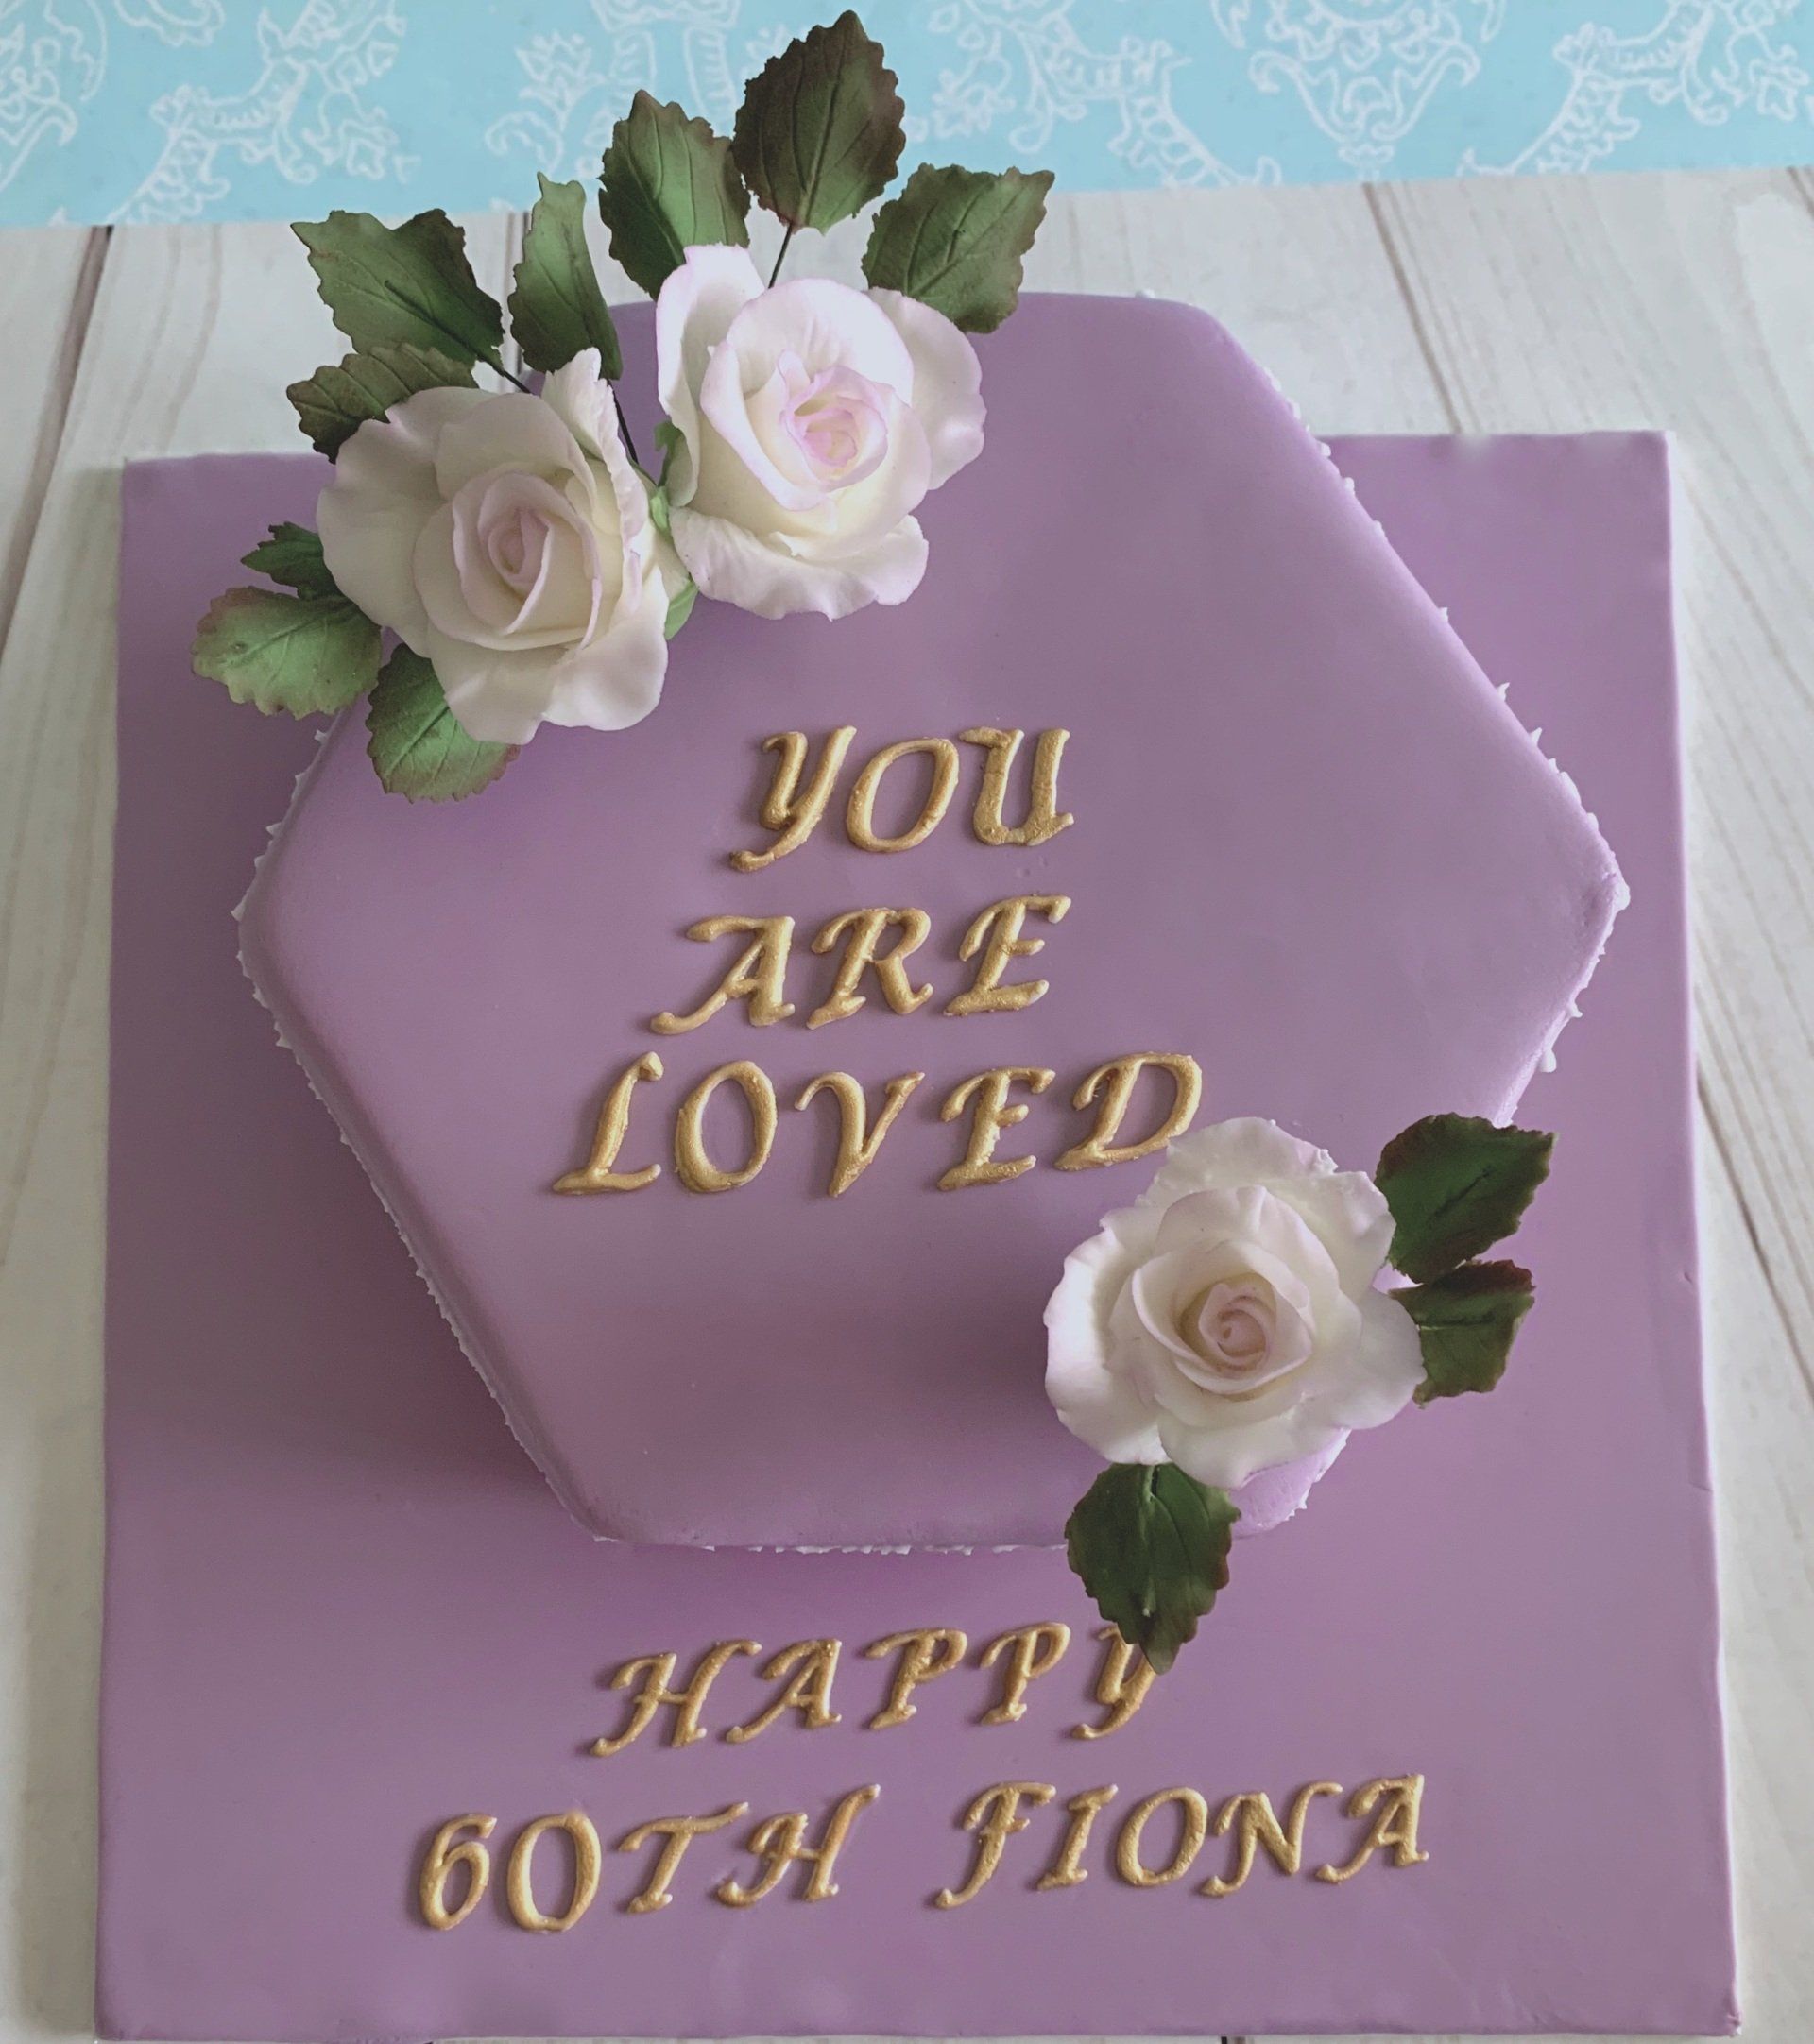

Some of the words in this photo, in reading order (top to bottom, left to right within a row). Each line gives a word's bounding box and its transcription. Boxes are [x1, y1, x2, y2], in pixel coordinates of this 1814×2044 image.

[730, 725, 1074, 872] YOU
[650, 894, 1071, 1035] ARE
[553, 1051, 1203, 1197] LOVED
[590, 1622, 1156, 1756] HAPPY
[418, 1784, 881, 1933] 60TH
[935, 1774, 1429, 1909] FIONA
